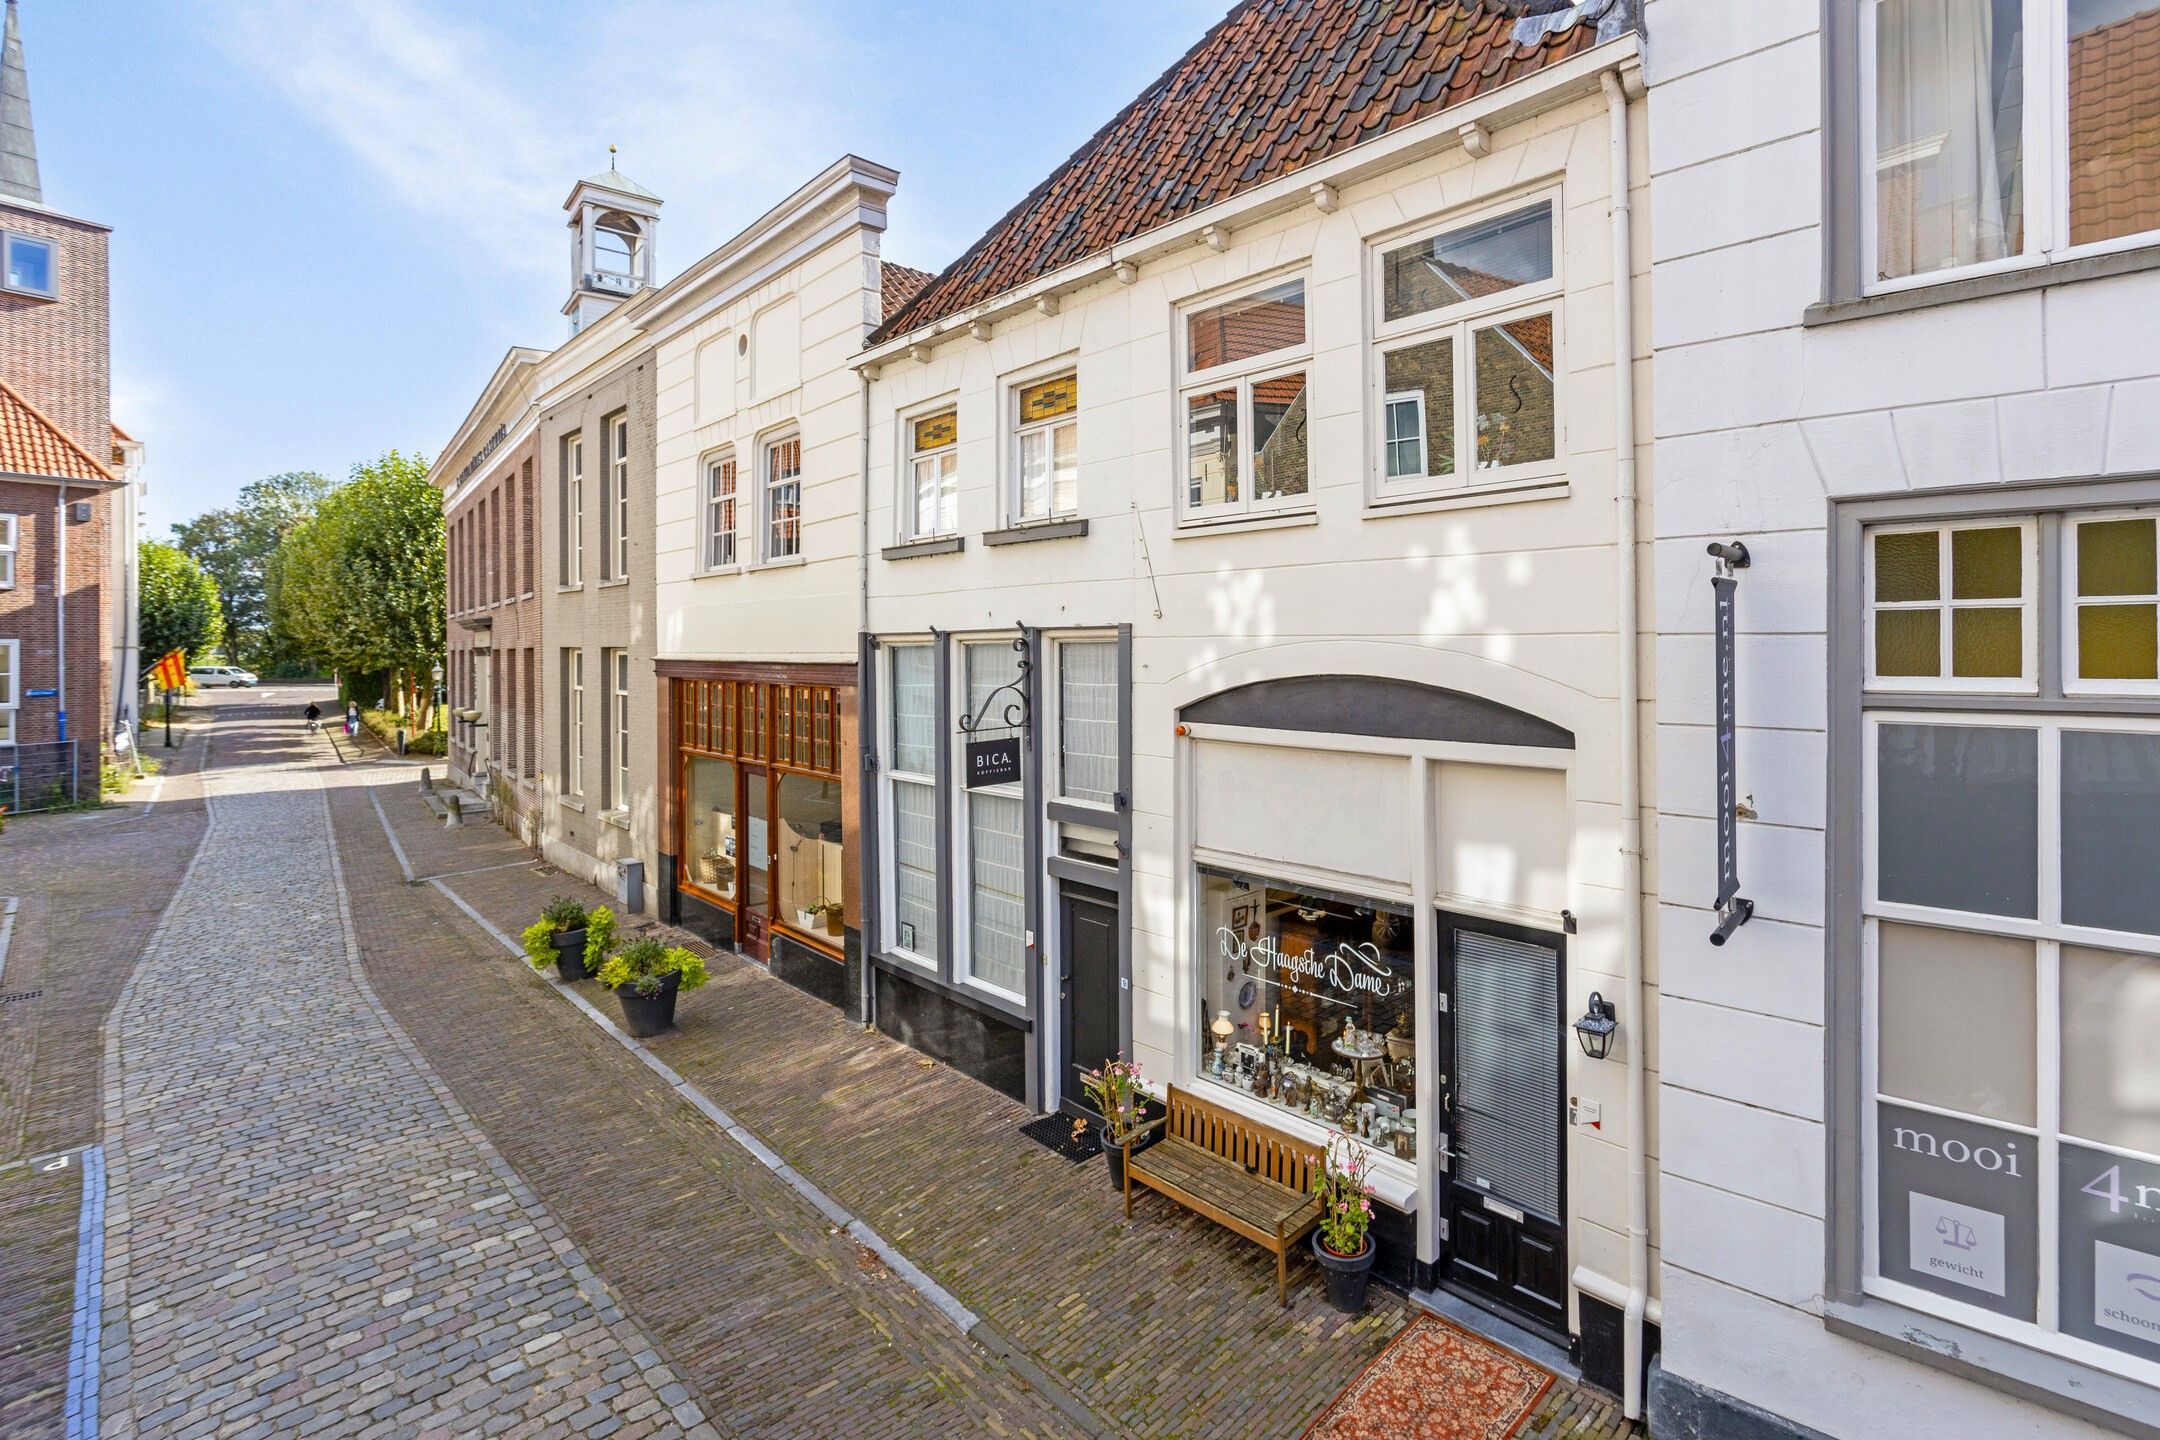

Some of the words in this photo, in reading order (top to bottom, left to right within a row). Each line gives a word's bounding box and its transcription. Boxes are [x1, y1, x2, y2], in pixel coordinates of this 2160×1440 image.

[1216, 924, 1248, 960] De
[1324, 942, 1392, 996] Dame
[1893, 1127, 2022, 1177] mooi
[1929, 1256, 1984, 1280] gewicht
